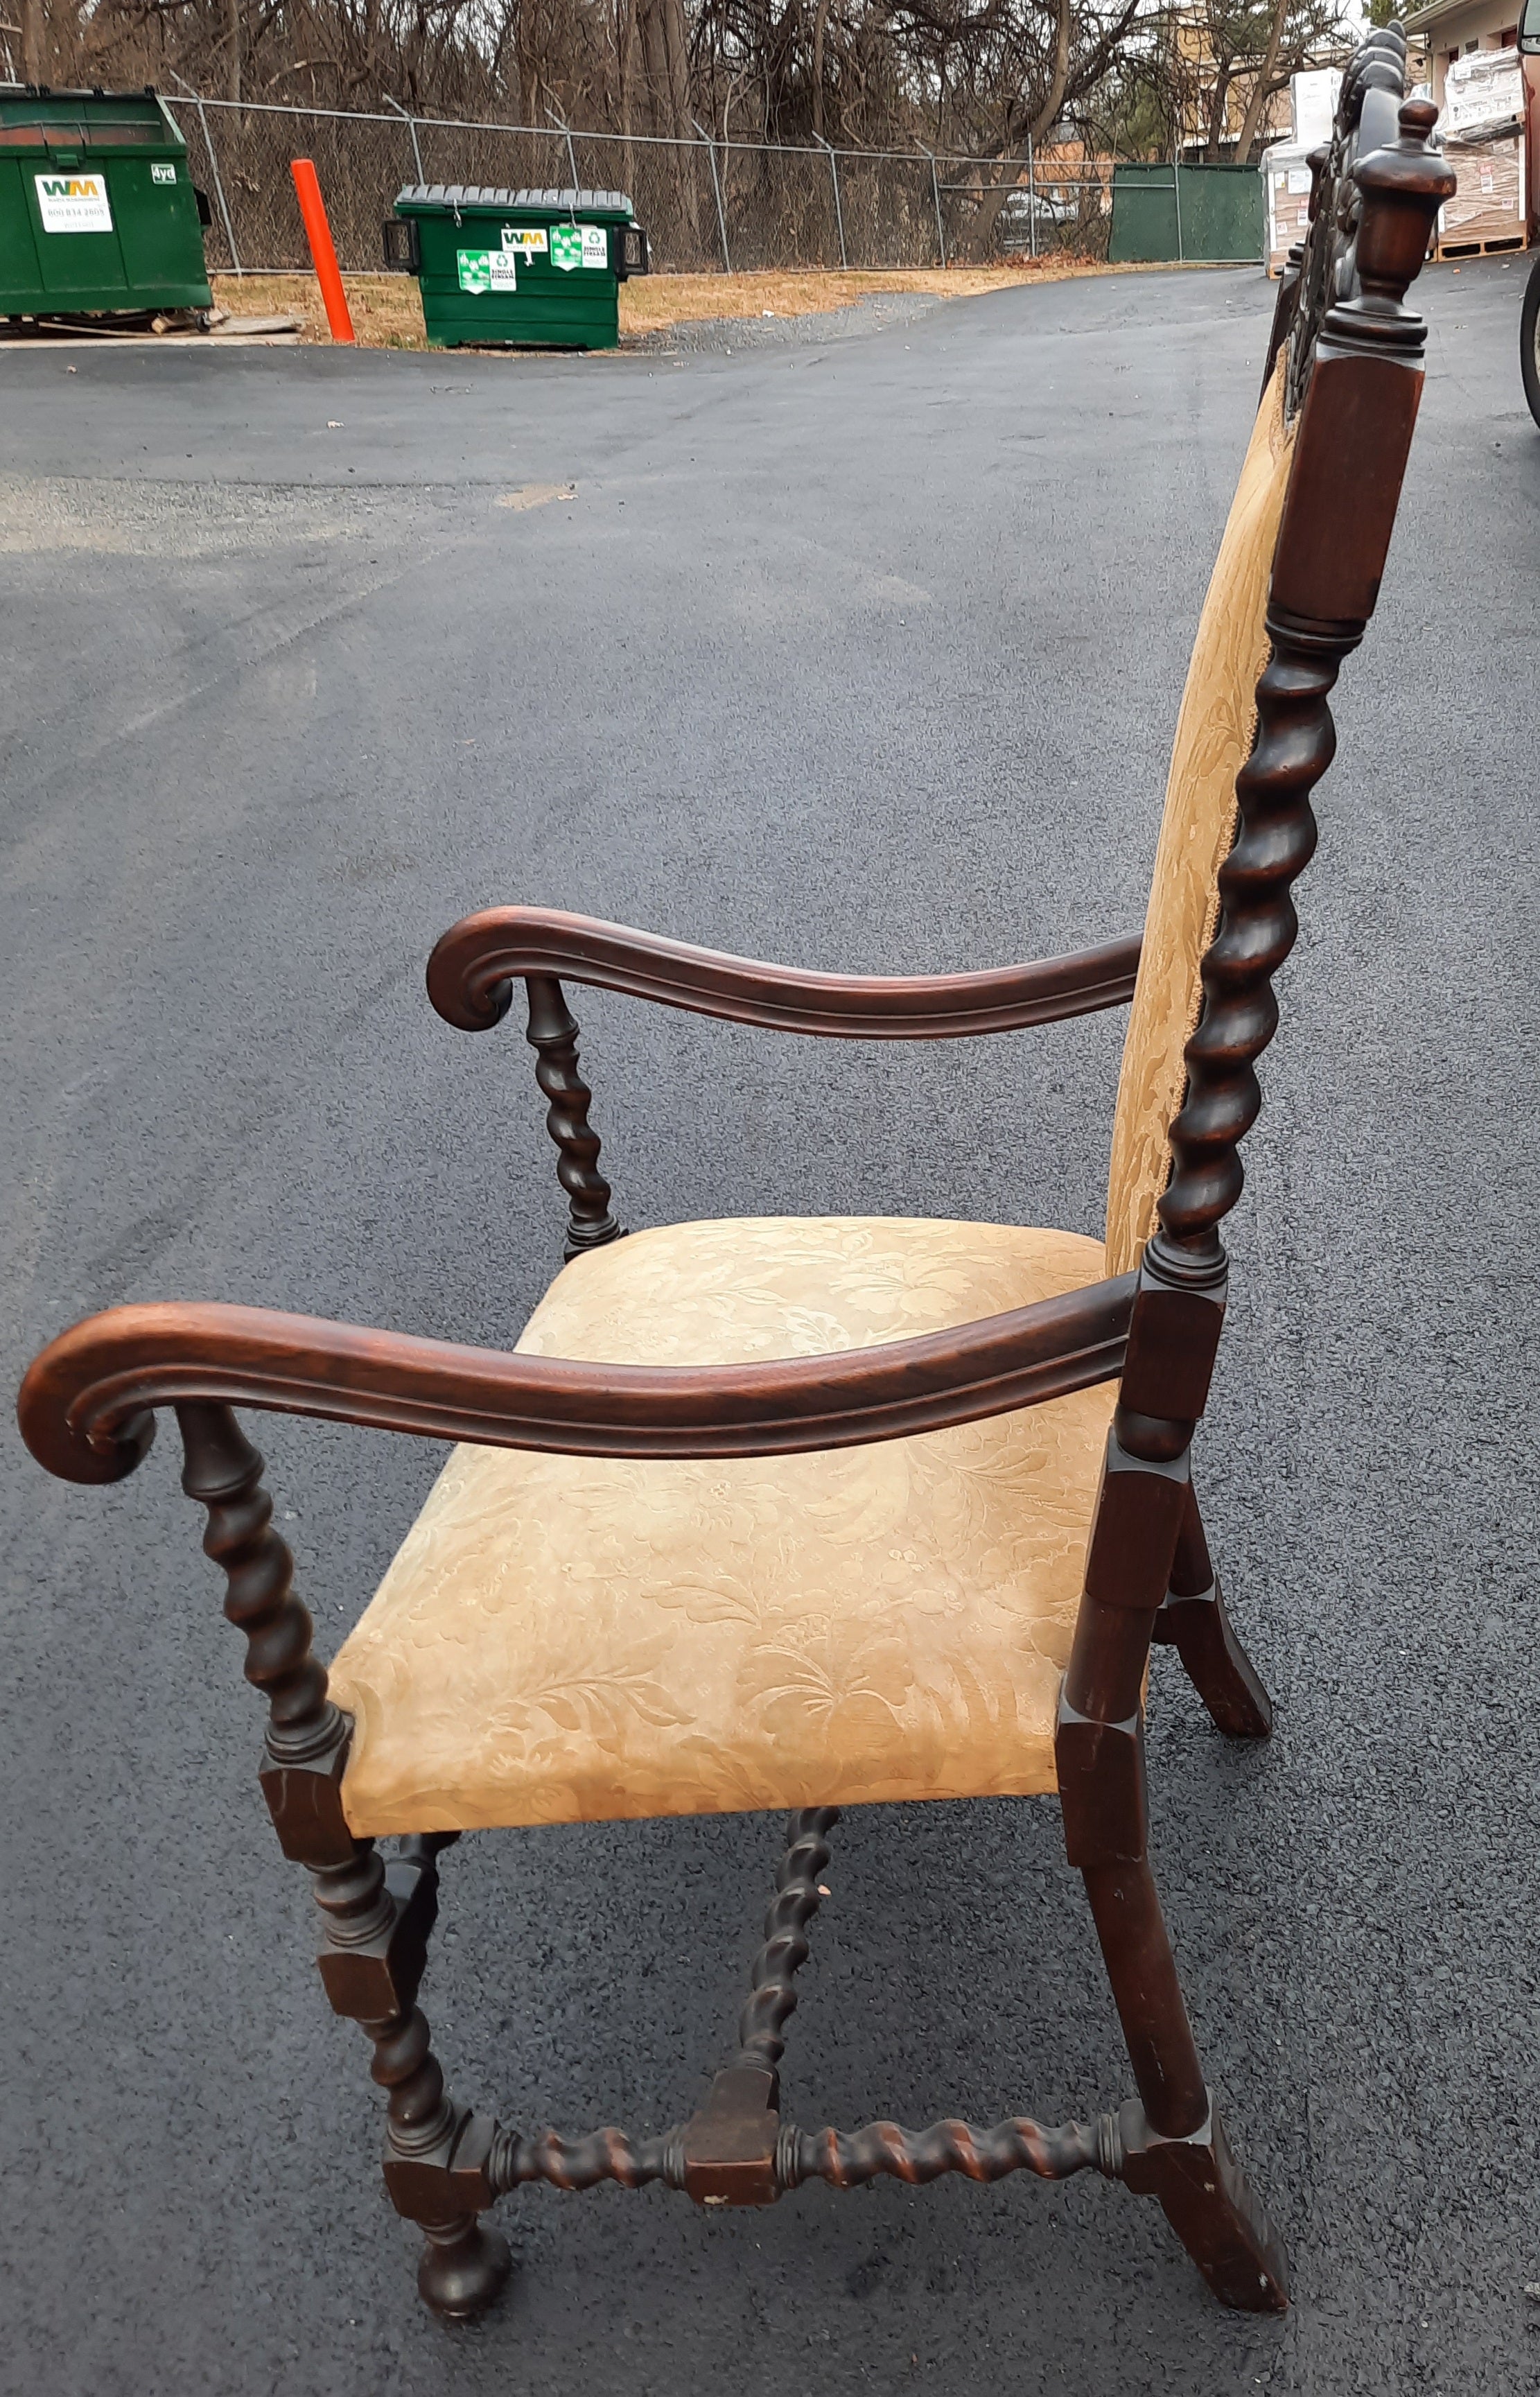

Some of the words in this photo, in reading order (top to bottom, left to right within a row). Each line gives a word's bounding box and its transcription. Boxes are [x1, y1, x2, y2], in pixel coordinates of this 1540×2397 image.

[154, 166, 175, 182] 4yd
[42, 180, 98, 196] WM
[503, 232, 544, 245] WM
